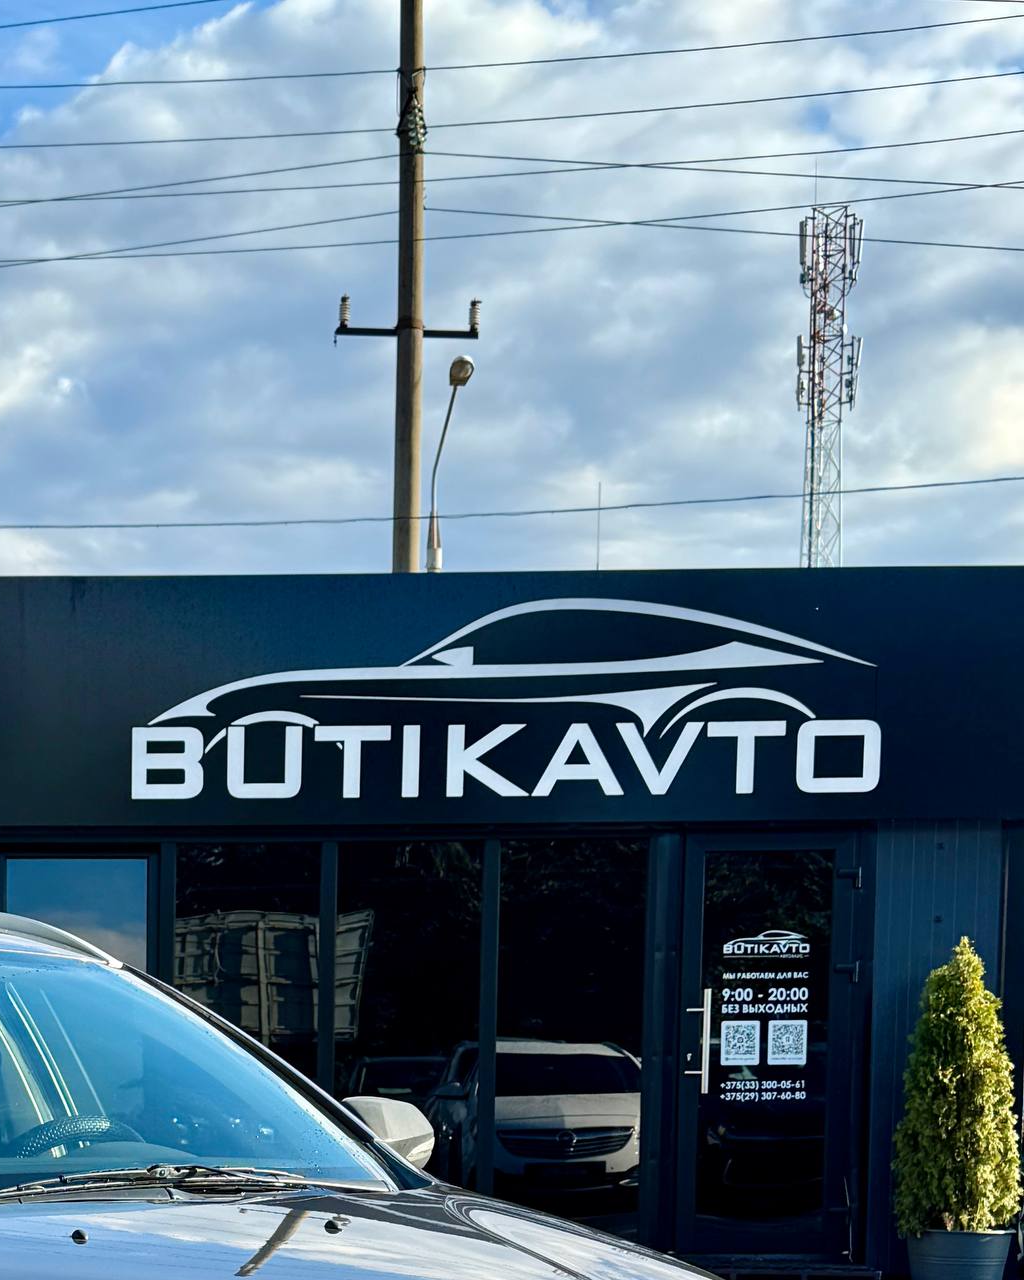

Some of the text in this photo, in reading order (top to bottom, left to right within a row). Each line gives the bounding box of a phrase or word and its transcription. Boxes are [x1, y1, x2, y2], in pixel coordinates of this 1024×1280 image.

[130, 717, 883, 800] BUTIKAVTO
[722, 943, 810, 954] BUTIKAVTO
[722, 971, 809, 980] МЫ РАБОТАЕМ ДЛЯ ВАС
[722, 988, 753, 1002] 9:00
[768, 987, 809, 1001] 20:00
[721, 1003, 808, 1014] БЕЗ ВЫХОДНЫХ
[720, 1080, 805, 1090] +375(33) 300-05-61
[720, 1091, 806, 1102] +375(29) 307-60-80
